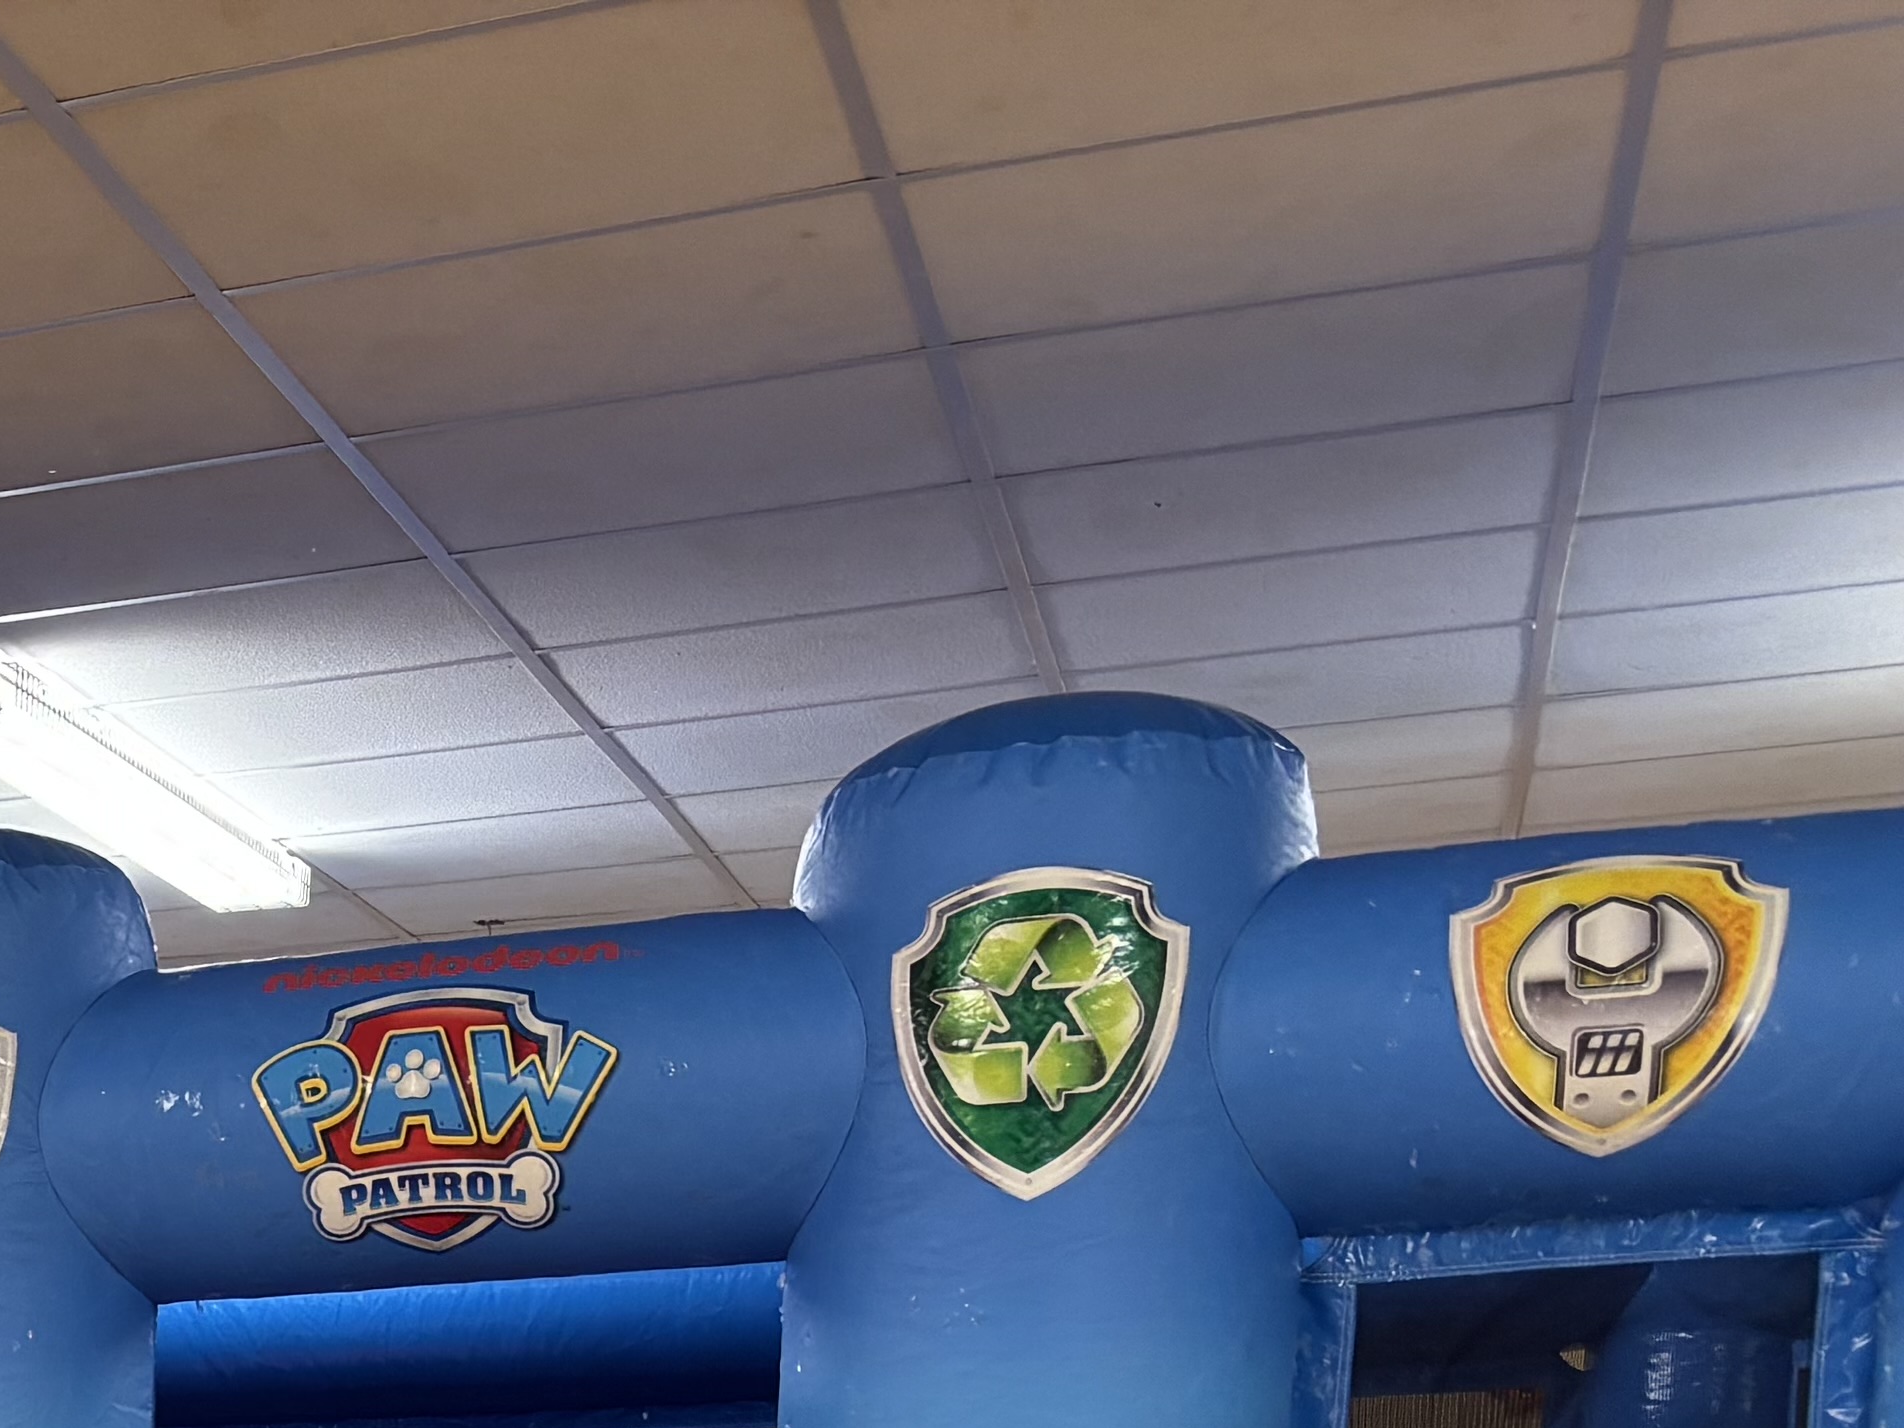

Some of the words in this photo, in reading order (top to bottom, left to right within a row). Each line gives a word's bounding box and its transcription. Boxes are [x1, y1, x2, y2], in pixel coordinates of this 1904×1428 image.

[263, 941, 620, 994] nickelodeon
[251, 1024, 618, 1172] PAW
[339, 1171, 527, 1217] PATROL
